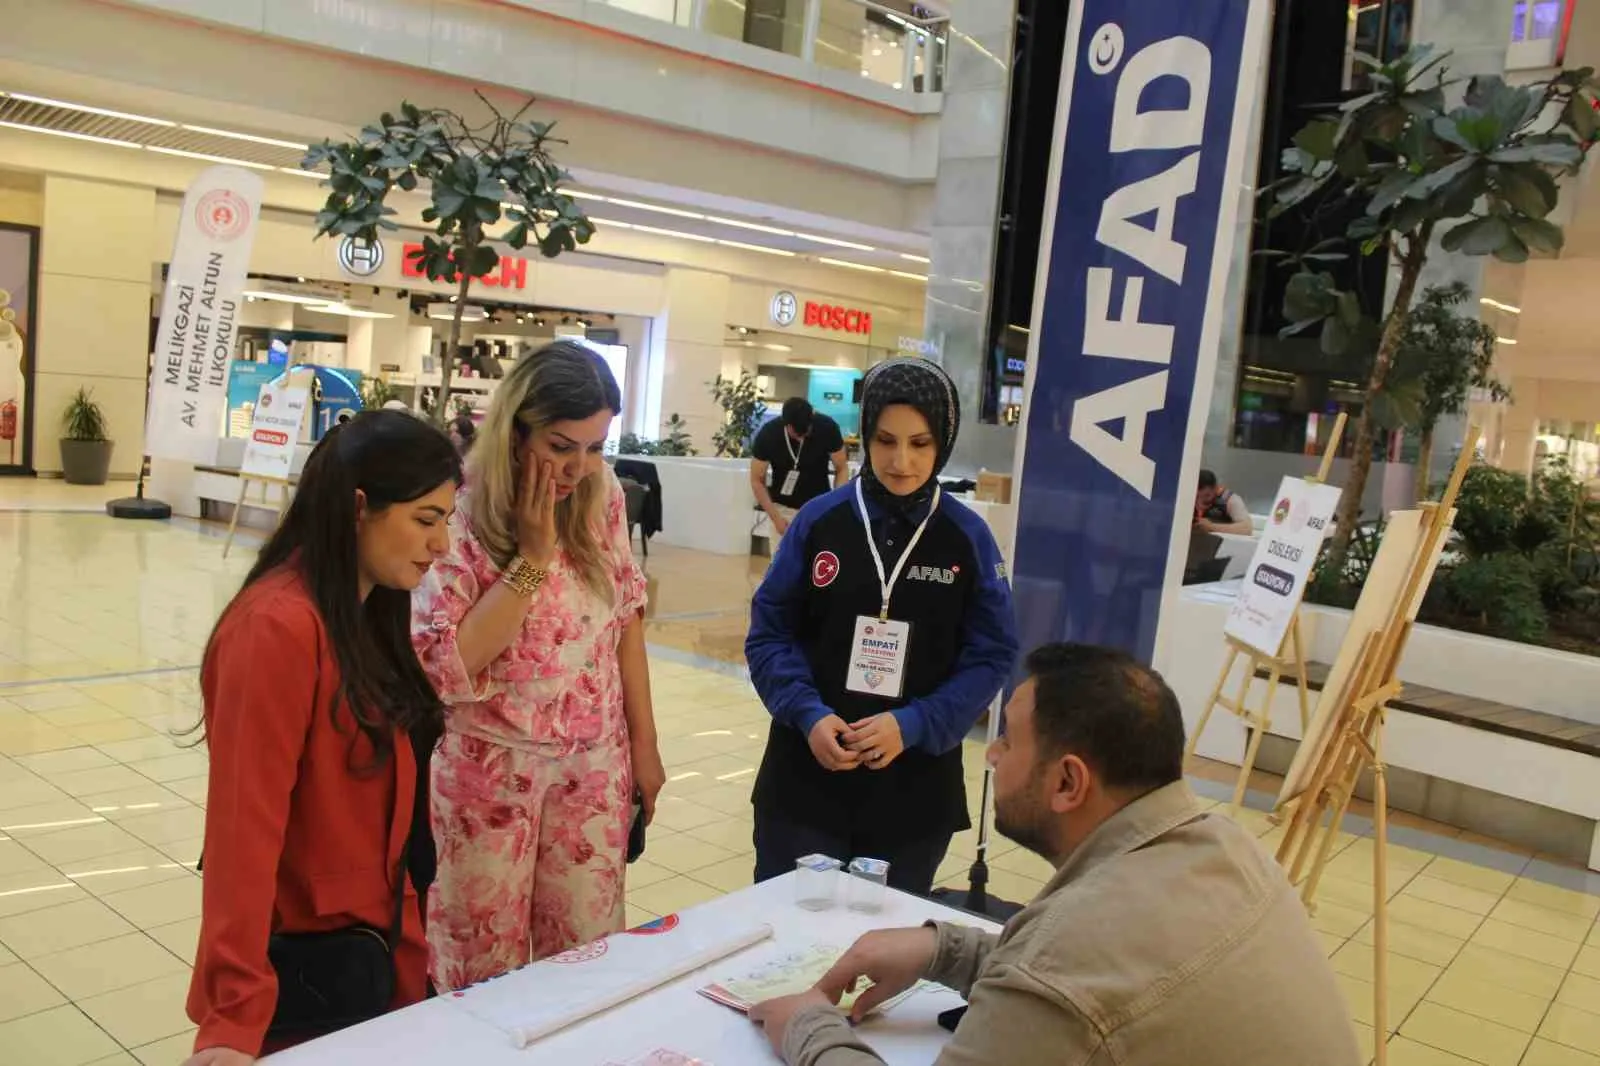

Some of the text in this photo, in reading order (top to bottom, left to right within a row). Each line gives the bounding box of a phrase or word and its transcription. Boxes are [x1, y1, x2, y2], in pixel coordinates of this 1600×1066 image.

[1069, 35, 1212, 501] AFAD
[165, 285, 195, 385] MELİKGAZİ
[181, 252, 225, 428] AV. MEHMET ALTUN
[210, 300, 237, 388] İLKOKULU
[803, 301, 873, 336] BOSCH
[906, 565, 955, 584] AFAD
[862, 639, 898, 650] EMPATİ
